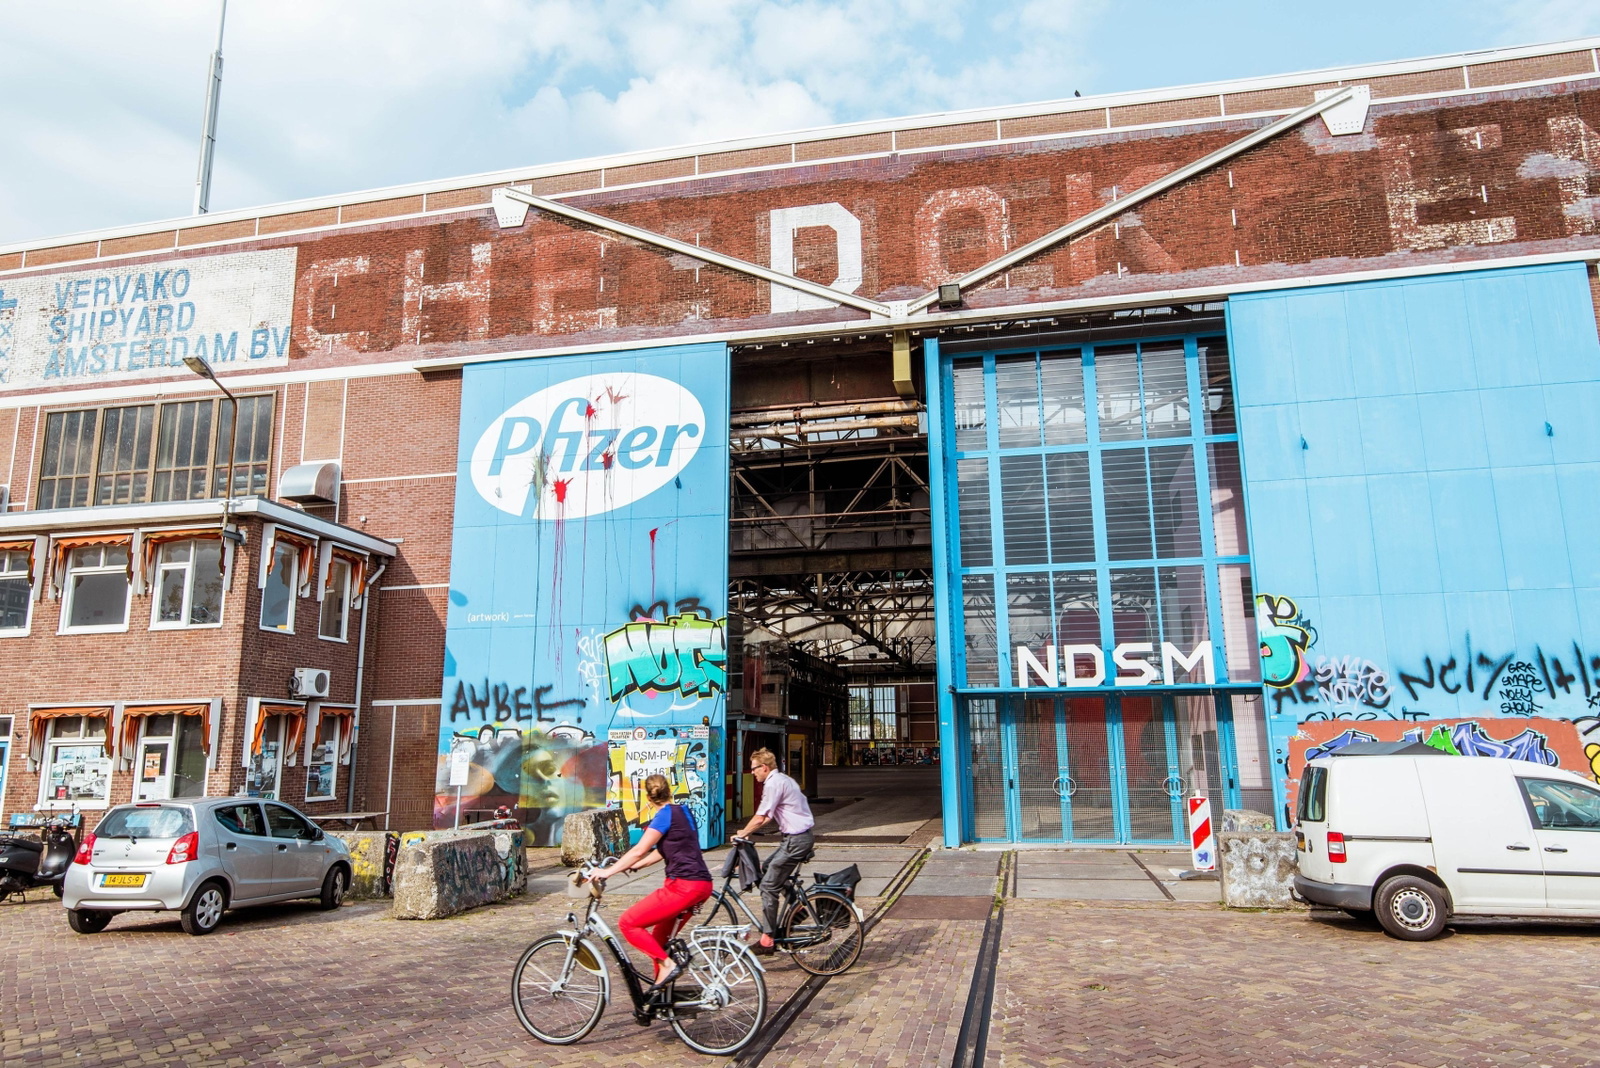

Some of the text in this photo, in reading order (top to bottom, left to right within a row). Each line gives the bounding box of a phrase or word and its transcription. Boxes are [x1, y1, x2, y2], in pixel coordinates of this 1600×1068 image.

[54, 269, 191, 312] VERVAKO
[48, 301, 196, 345] SHIPYARD
[44, 326, 291, 380] AMSTERDAM BV
[487, 397, 700, 518] Pfizer
[467, 612, 510, 624] (artwork)
[1017, 641, 1216, 688] NDSM
